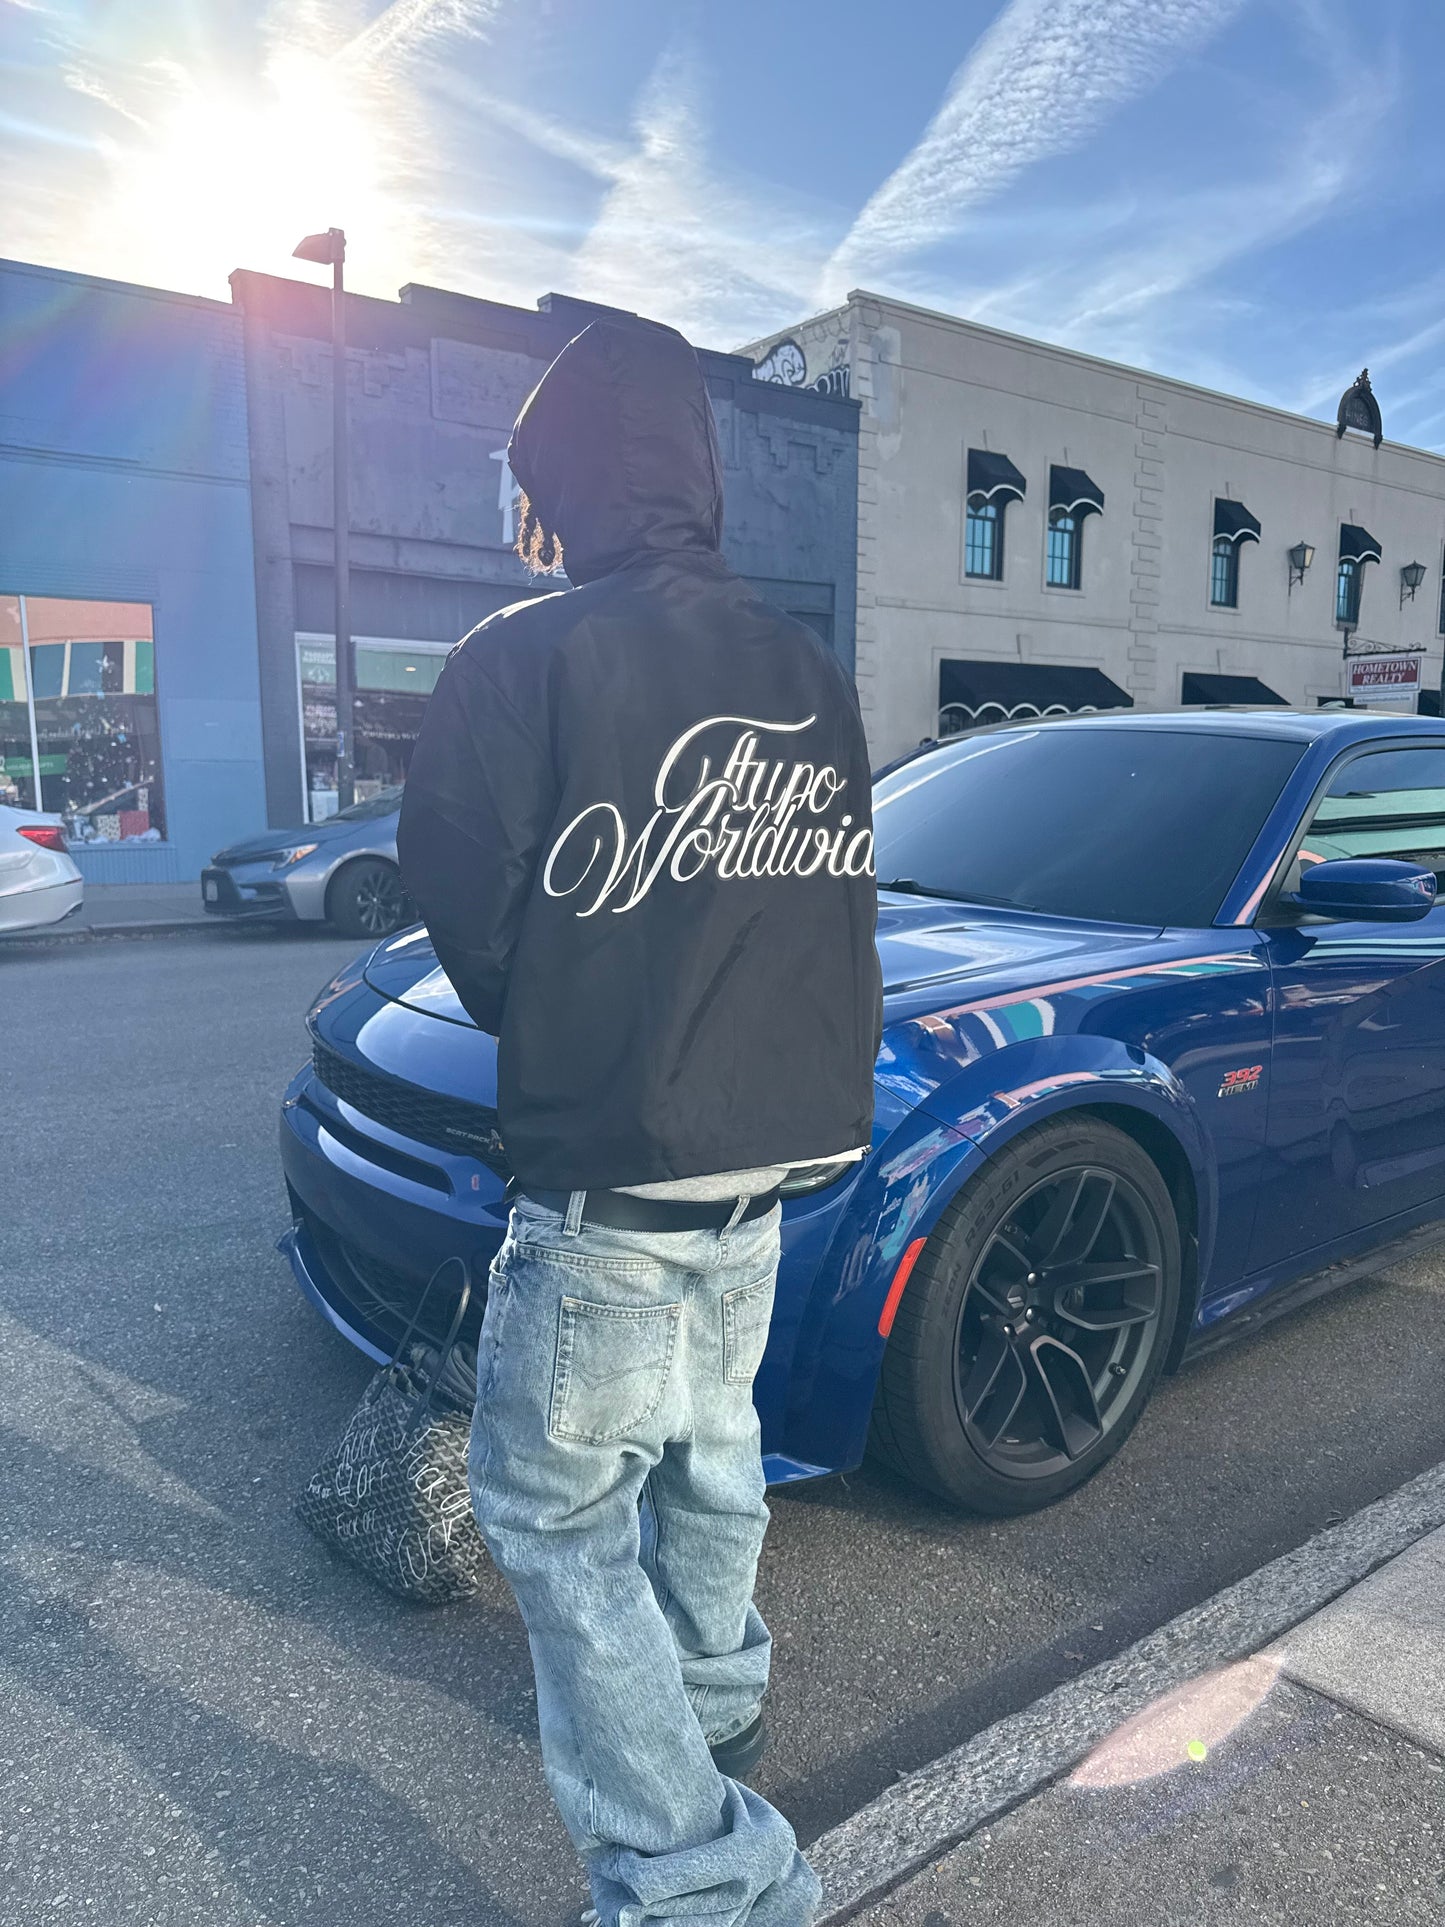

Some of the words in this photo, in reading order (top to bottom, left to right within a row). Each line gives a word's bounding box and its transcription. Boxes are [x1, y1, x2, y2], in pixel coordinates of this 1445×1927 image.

[1353, 660, 1418, 675] HOMETOWN
[1362, 672, 1405, 685] REALTY
[1221, 1065, 1263, 1088] 392
[1217, 1080, 1259, 1098] HEMI
[400, 1428, 451, 1500] FUCK
[357, 1458, 390, 1498] OFF
[397, 1515, 459, 1588] FUCK
